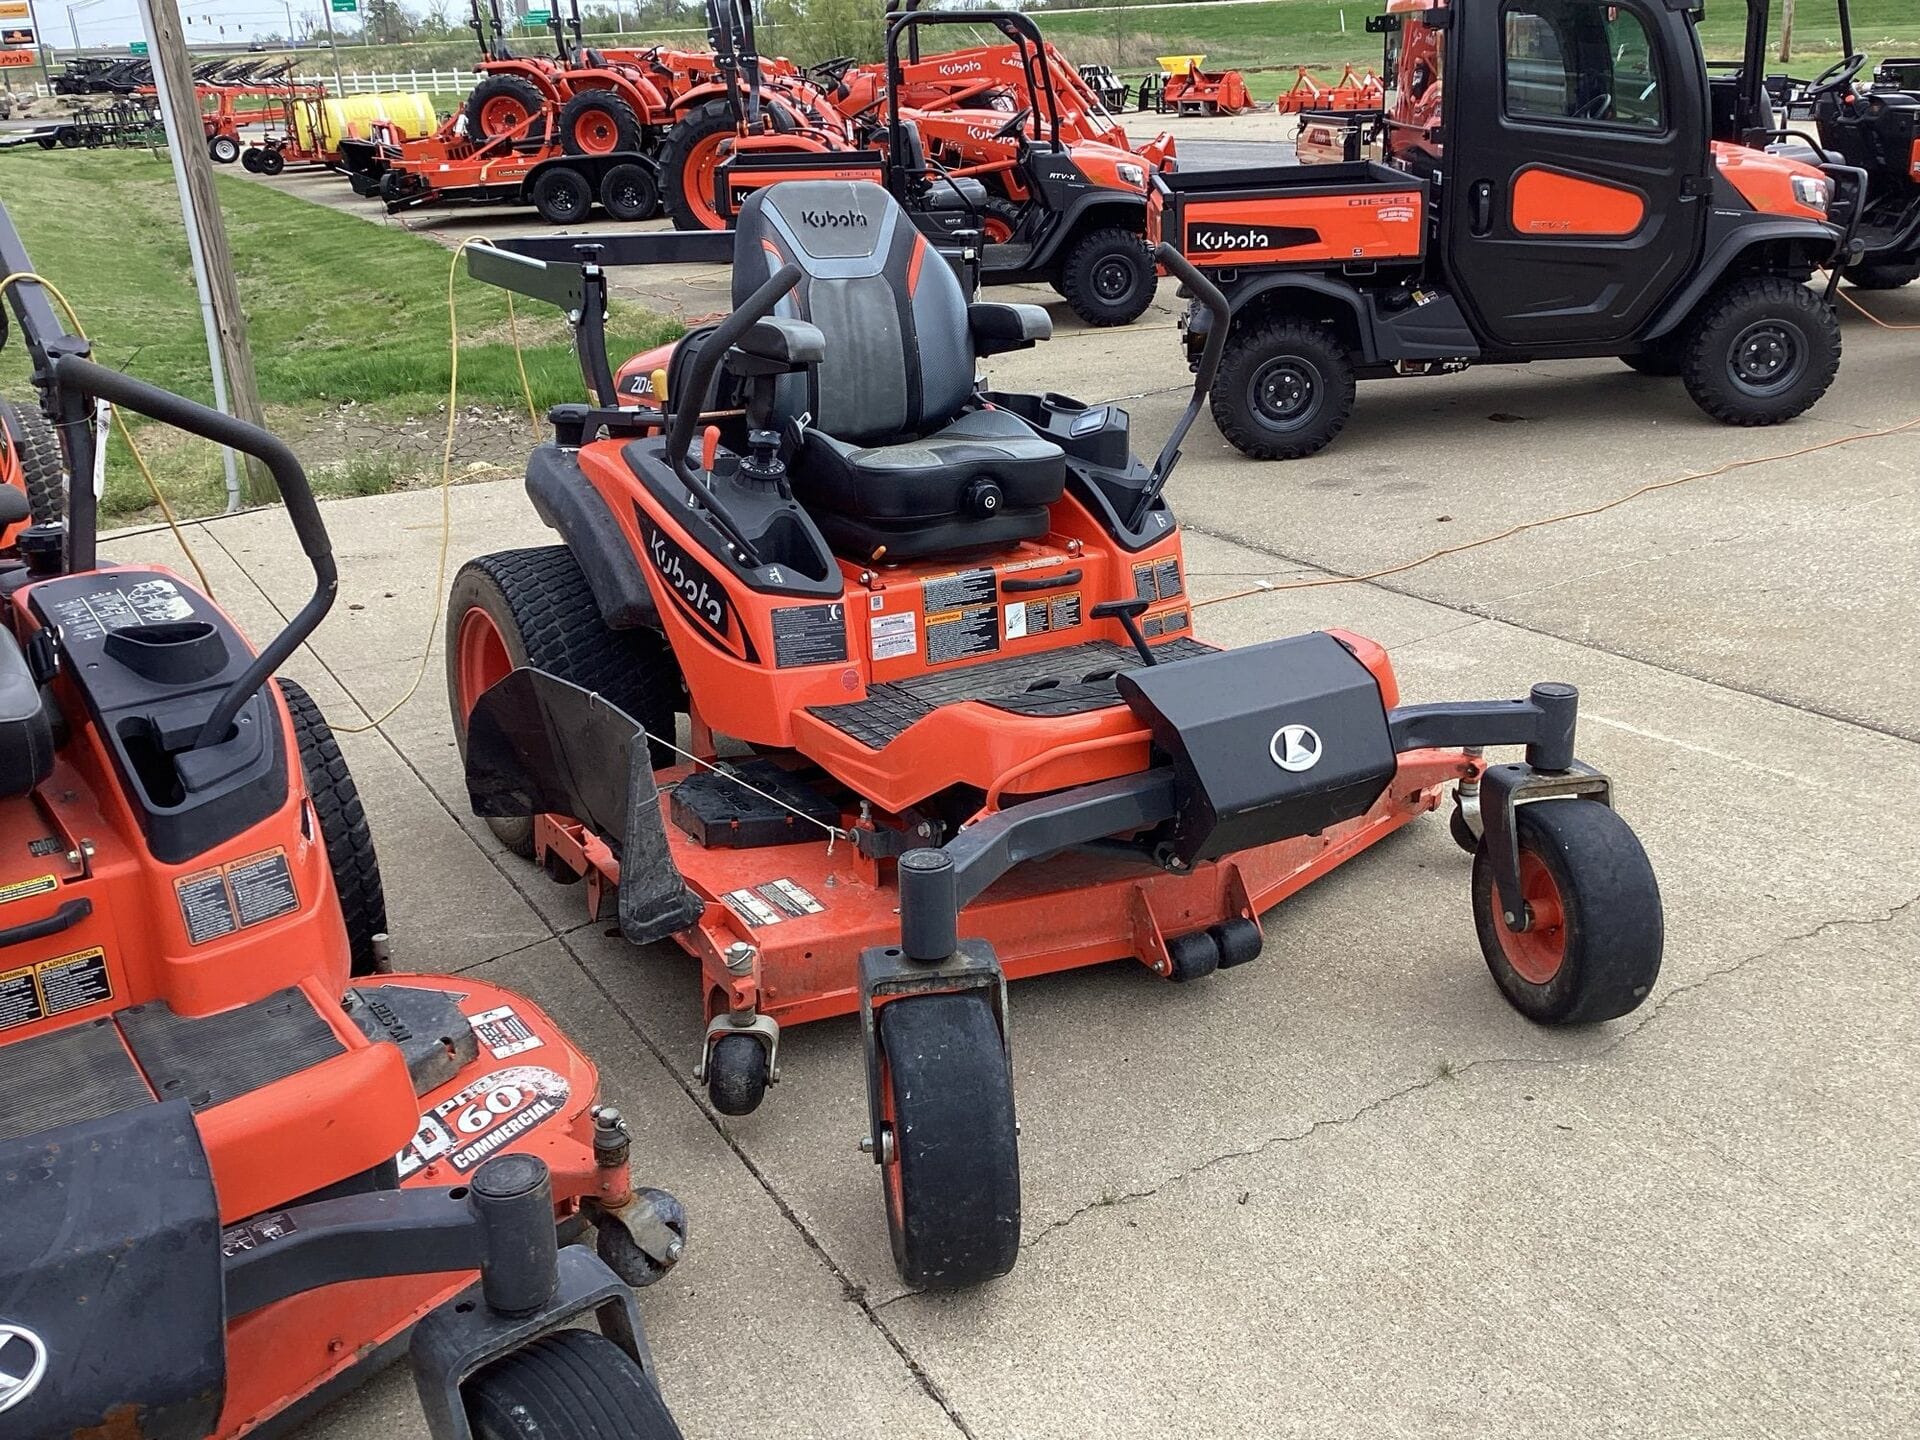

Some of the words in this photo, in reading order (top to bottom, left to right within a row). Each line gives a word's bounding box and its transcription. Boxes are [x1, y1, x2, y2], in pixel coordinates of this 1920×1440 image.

[0, 54, 30, 63] ubota
[939, 60, 982, 75] Kubota
[1348, 196, 1415, 207] DIESEL
[802, 210, 868, 228] Kubota
[1196, 230, 1269, 249] Kubota
[651, 529, 722, 625] Kubota
[184, 868, 218, 883] WARNING
[236, 848, 278, 867] ADVERTENCIA
[0, 969, 28, 981] ARNING
[48, 949, 99, 967] ADVERTENCIA
[457, 1085, 524, 1134] 60
[452, 1099, 556, 1169] COMMERCIAL
